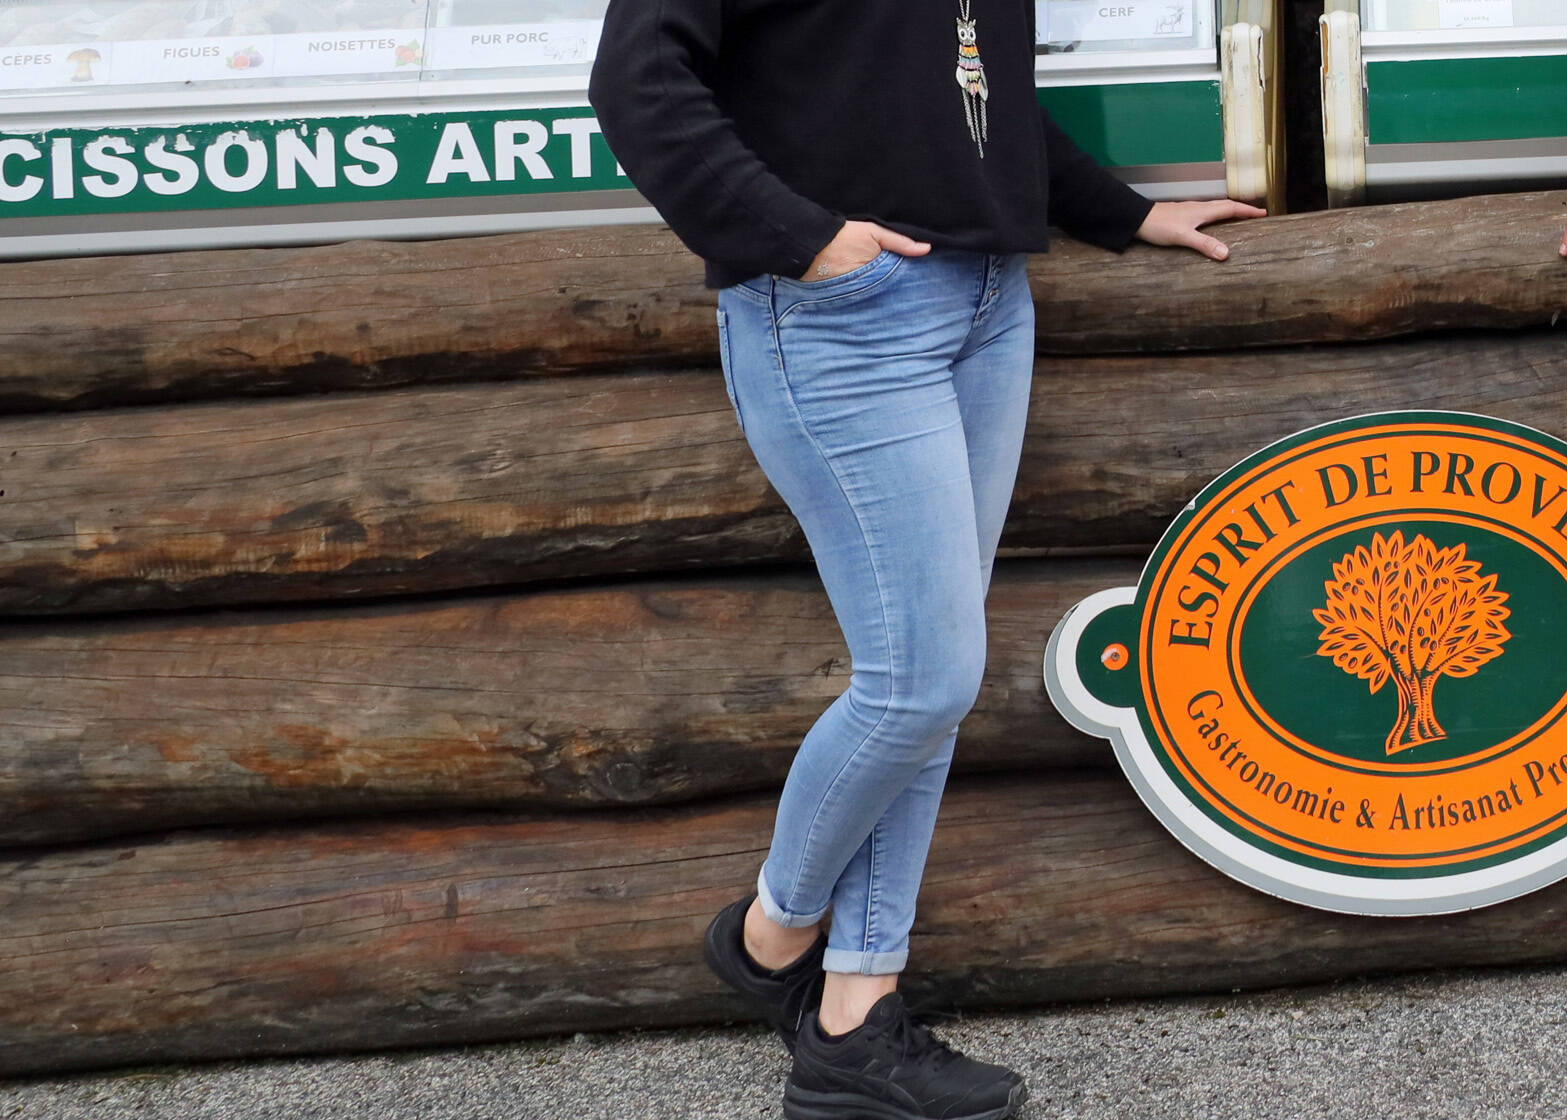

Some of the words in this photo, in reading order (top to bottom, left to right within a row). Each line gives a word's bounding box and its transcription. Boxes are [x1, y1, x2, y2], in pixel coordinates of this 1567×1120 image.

[163, 46, 220, 60] FIGUES
[308, 38, 396, 53] NOISETTES
[471, 34, 501, 46] PUR
[506, 32, 548, 44] PORC
[1098, 7, 1135, 19] CERF
[0, 125, 399, 203] CISSONS
[426, 117, 628, 184] ART
[1168, 481, 1302, 650] ESPRIT
[1314, 452, 1393, 509] DE
[1185, 690, 1345, 824] Gastronomie
[1356, 800, 1377, 829] &
[1388, 780, 1524, 831] Artisanat
